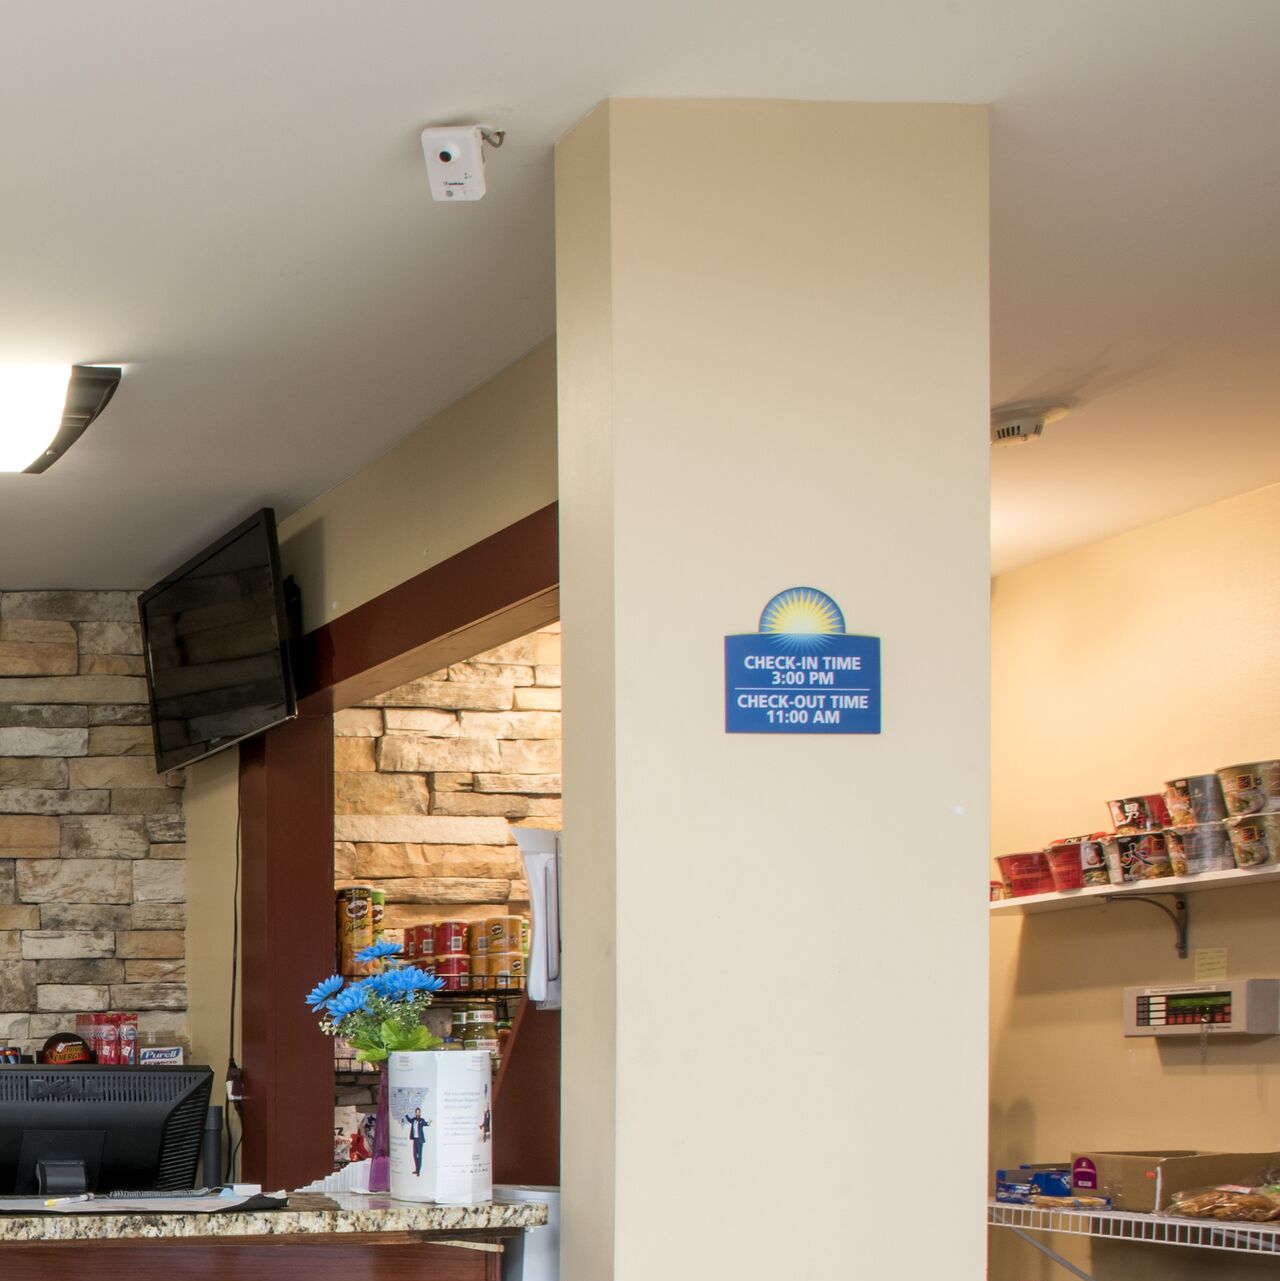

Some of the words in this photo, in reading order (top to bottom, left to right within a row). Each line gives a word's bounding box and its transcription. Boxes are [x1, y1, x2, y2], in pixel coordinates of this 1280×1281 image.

[743, 656, 818, 670] CHECK-IN
[822, 656, 861, 670] TIME
[771, 671, 805, 685] 3:00
[809, 672, 834, 685] PM
[737, 694, 826, 709] CHECK-OUT
[830, 695, 869, 709] TIME
[766, 710, 808, 724] 11:00
[812, 710, 840, 724] AM
[145, 1050, 177, 1059] Purell
